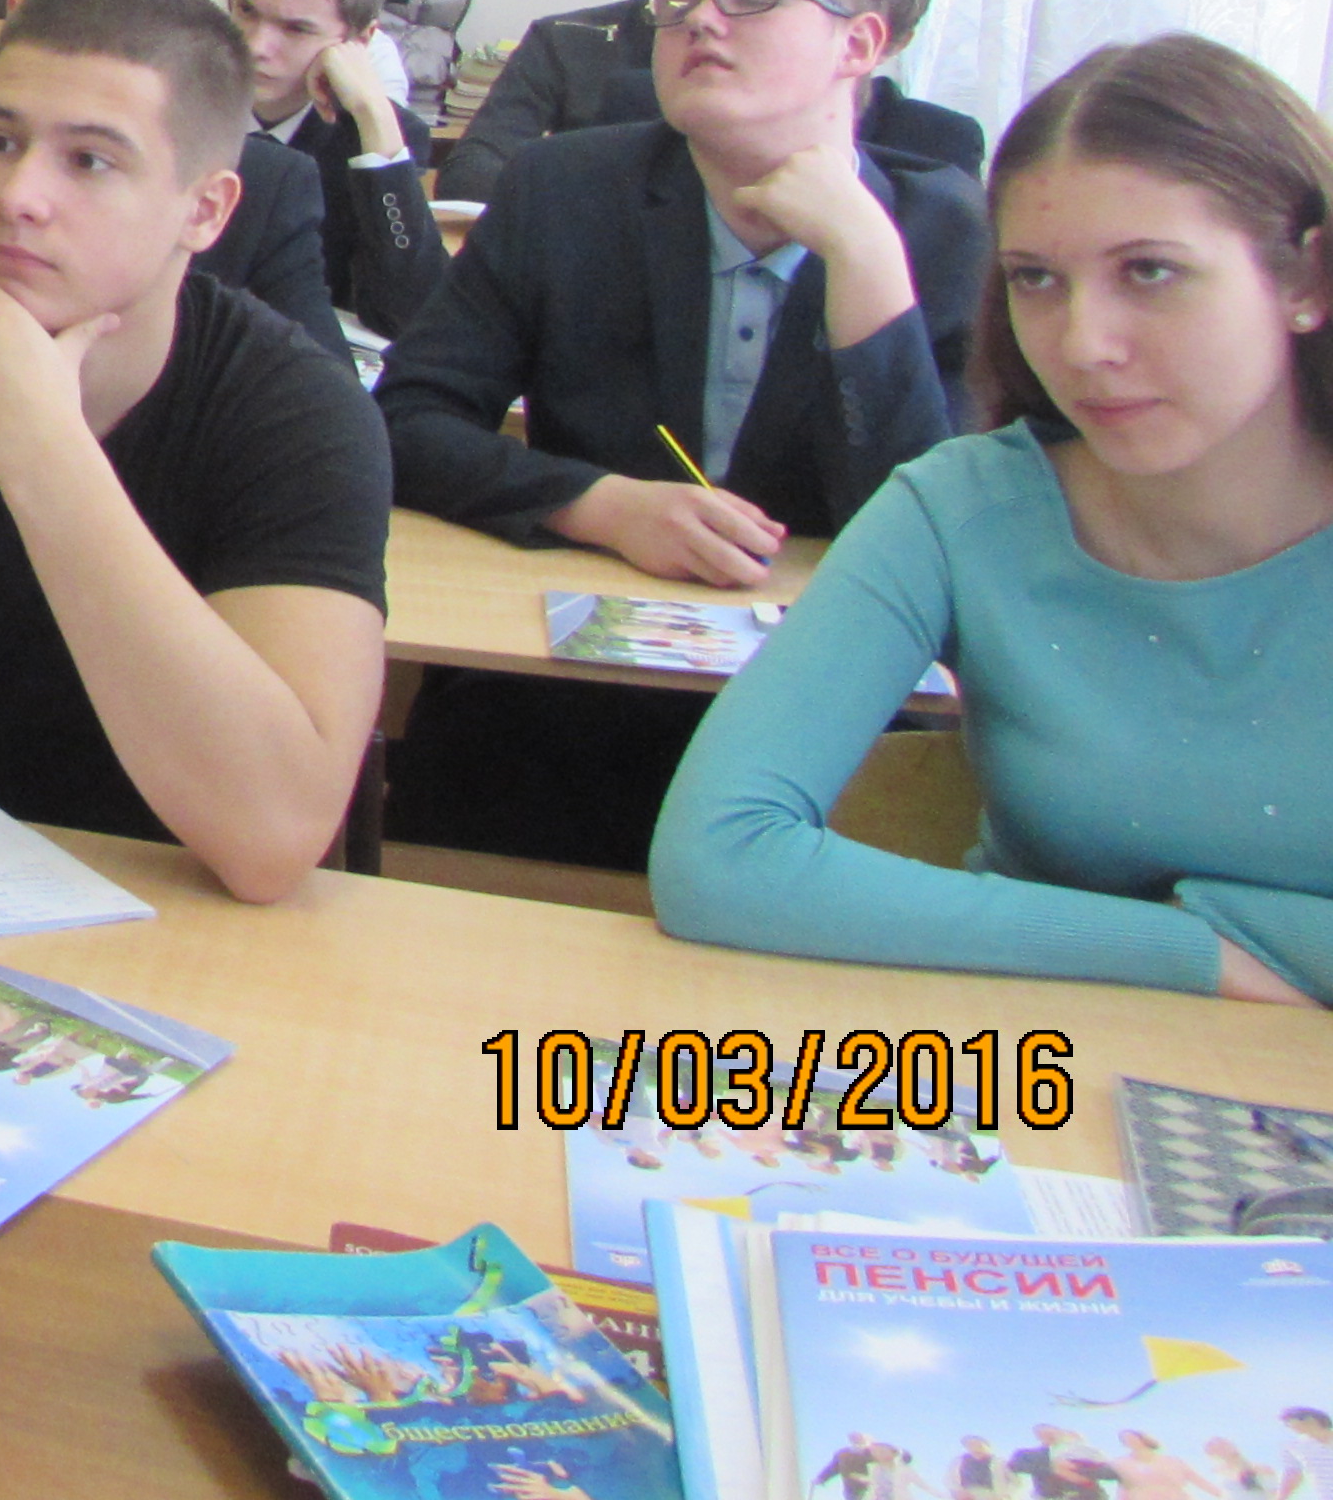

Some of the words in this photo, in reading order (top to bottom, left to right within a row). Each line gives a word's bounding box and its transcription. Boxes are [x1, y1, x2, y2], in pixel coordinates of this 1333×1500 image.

[810, 1244, 881, 1260] ВСЕ
[891, 1248, 918, 1262] О
[930, 1249, 1108, 1269] БУДУЩЕЙ
[815, 1261, 1117, 1299] ПЕНСИИ
[818, 1288, 876, 1304] ДЛЯ
[990, 1297, 1010, 1311] И
